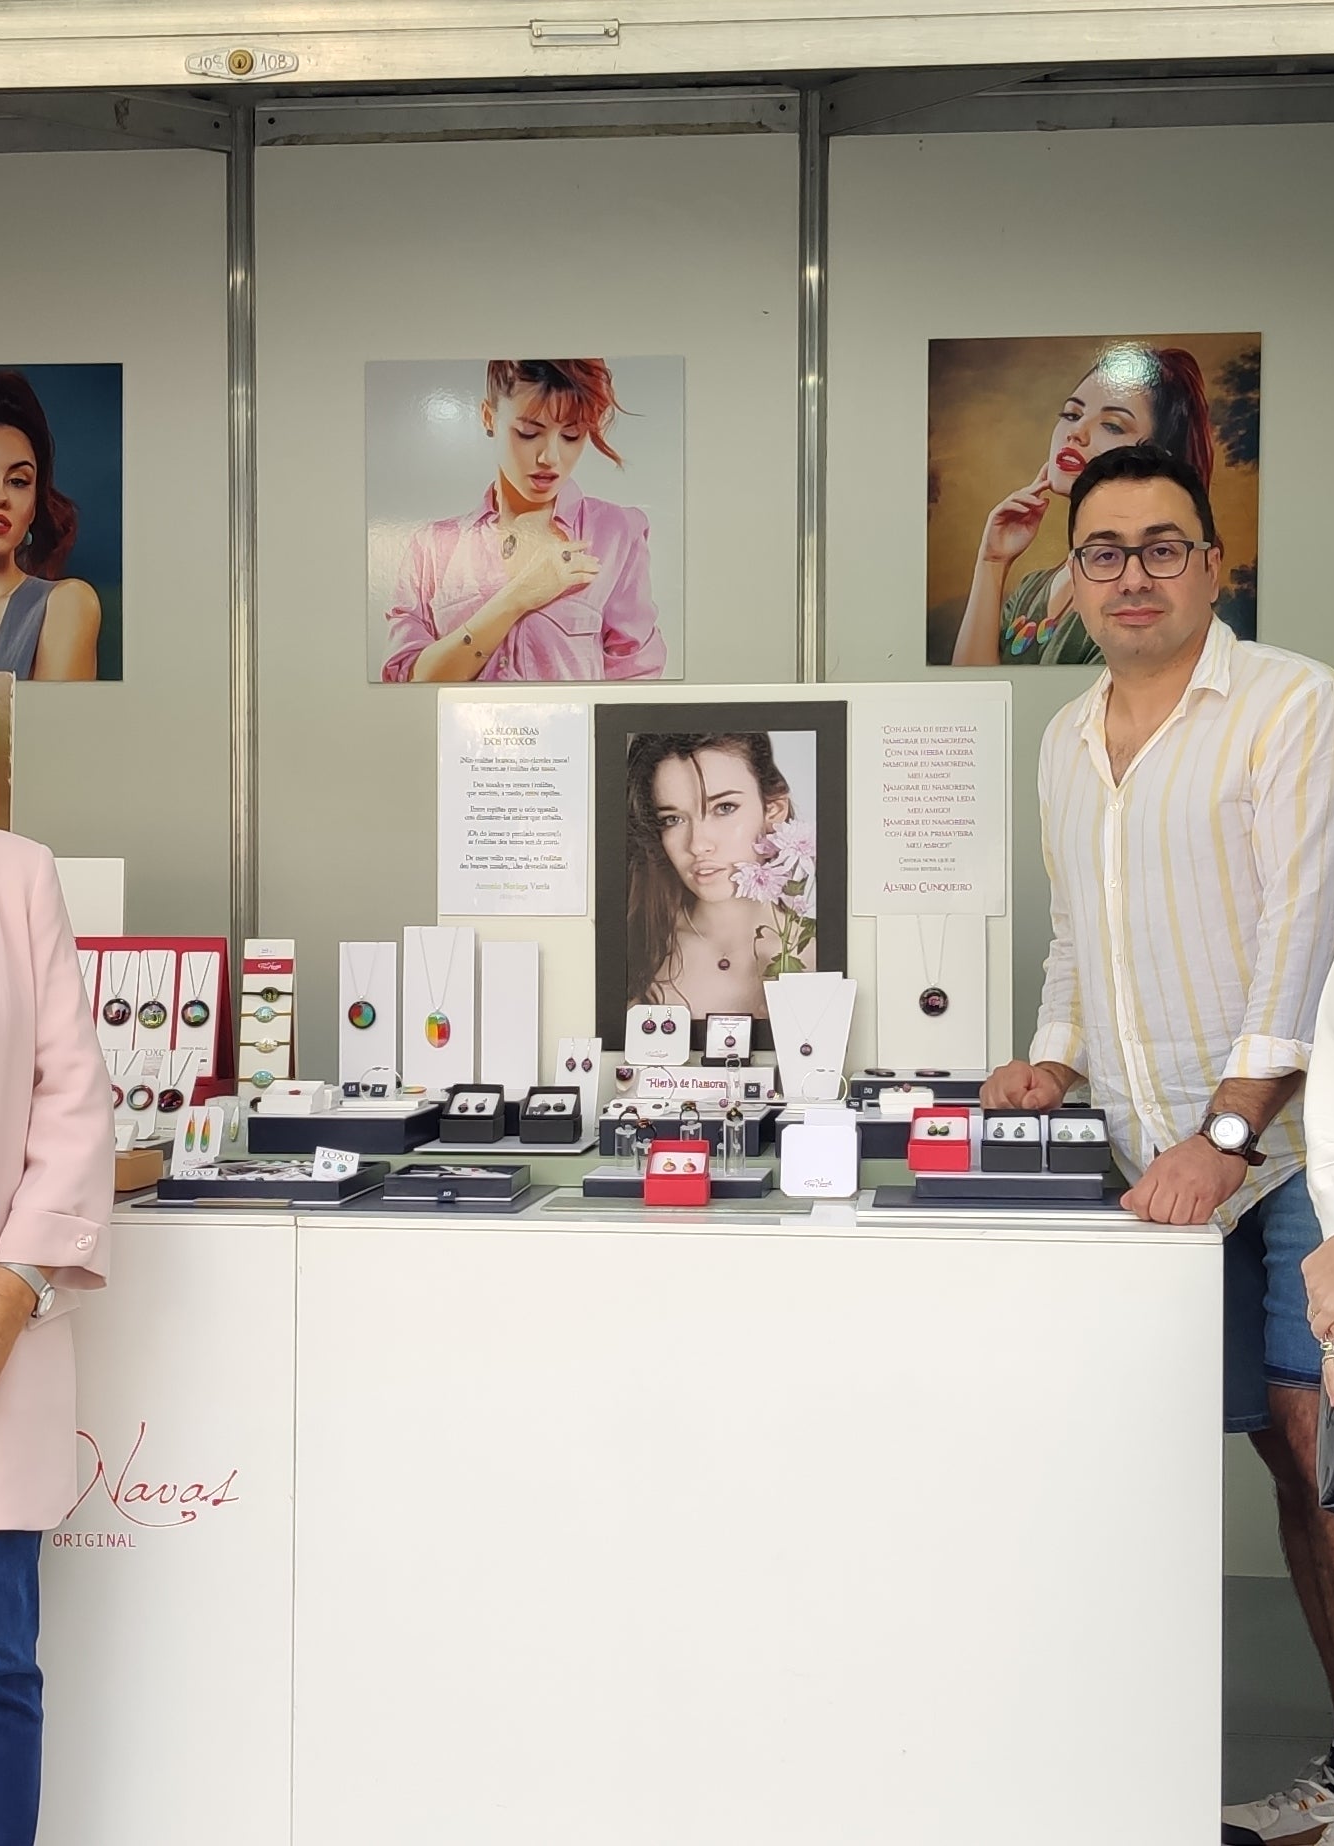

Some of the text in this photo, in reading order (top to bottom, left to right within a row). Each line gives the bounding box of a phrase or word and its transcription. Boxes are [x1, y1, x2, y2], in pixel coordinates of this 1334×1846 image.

[504, 737, 537, 746] TOXOS
[919, 882, 973, 893] CUNQUEIRO
[679, 1079, 690, 1088] de
[52, 1533, 137, 1548] ORIGINAL
